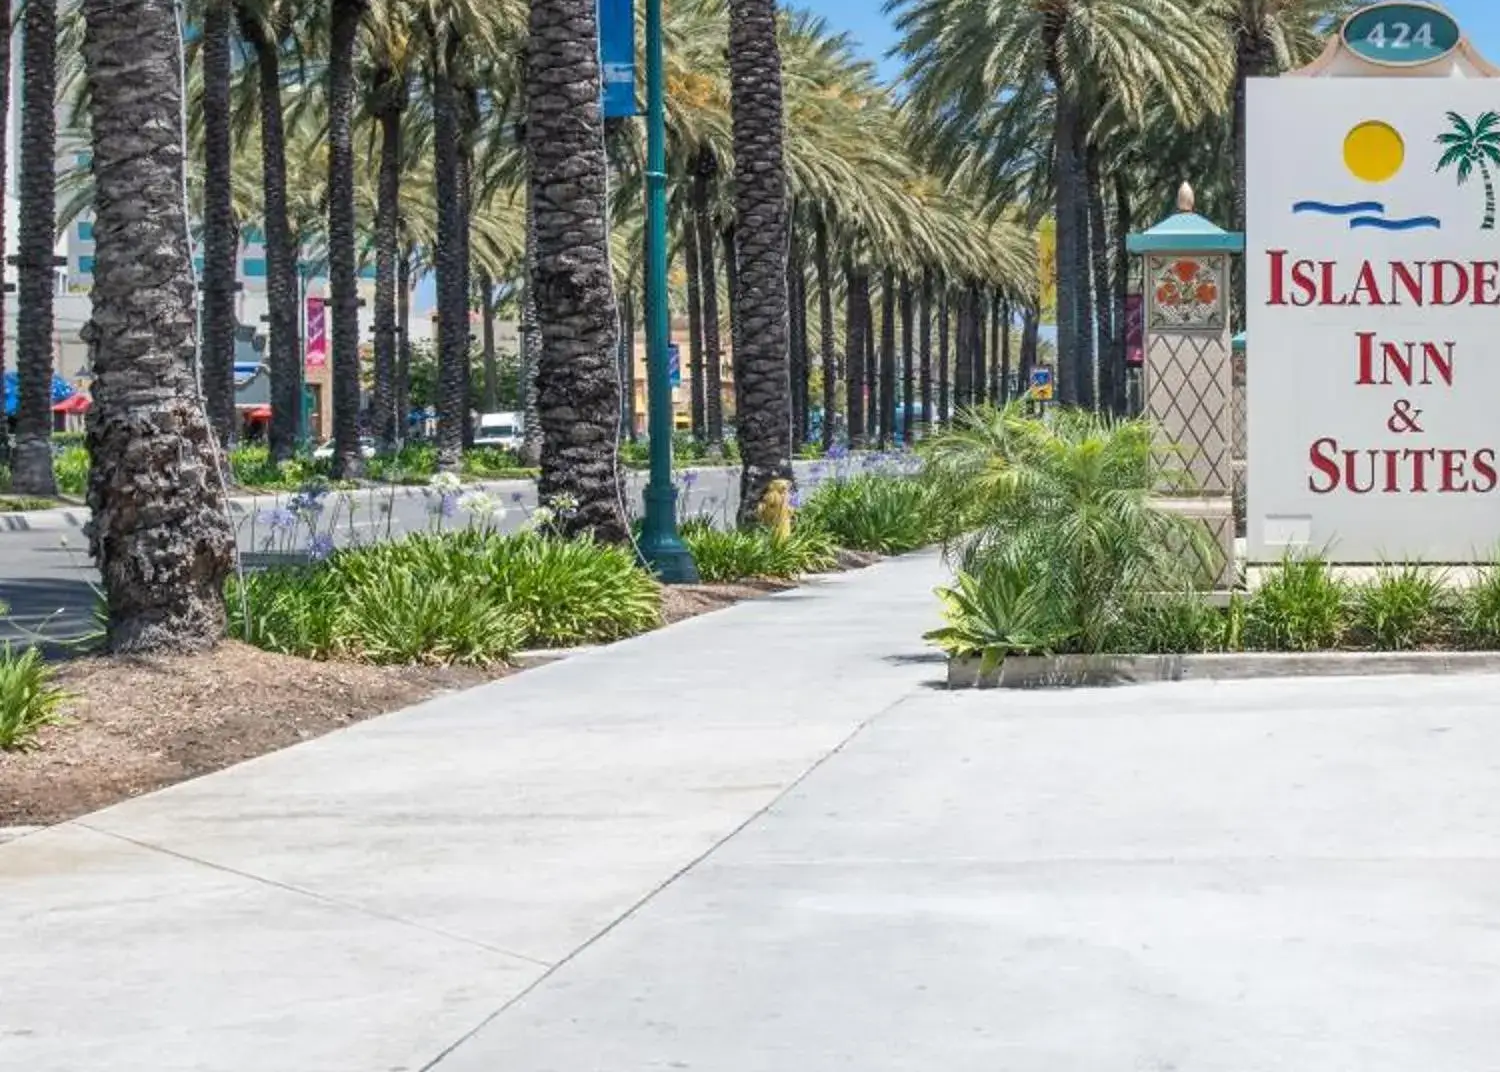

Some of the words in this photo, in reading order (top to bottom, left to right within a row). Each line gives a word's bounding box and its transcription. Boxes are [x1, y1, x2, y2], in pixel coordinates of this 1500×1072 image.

[1365, 21, 1435, 49] 424
[1354, 332, 1456, 386] INN
[1387, 399, 1424, 433] &
[1309, 438, 1498, 494] SUITES
